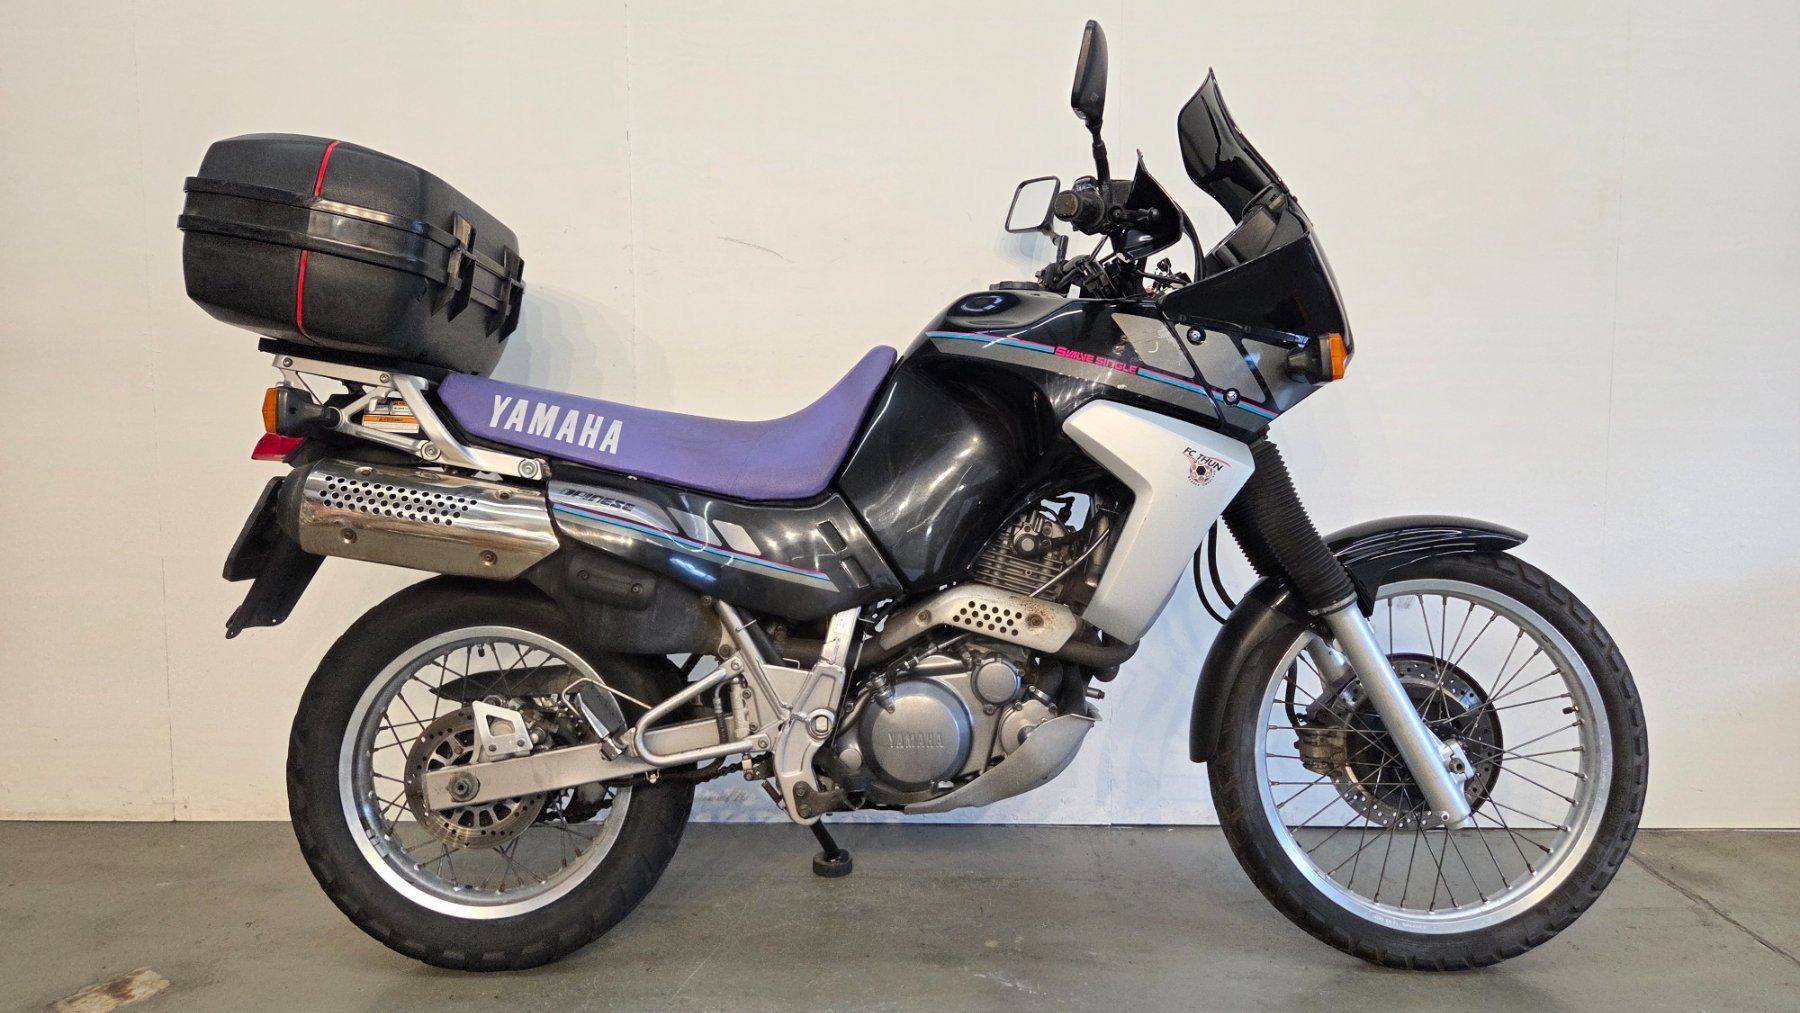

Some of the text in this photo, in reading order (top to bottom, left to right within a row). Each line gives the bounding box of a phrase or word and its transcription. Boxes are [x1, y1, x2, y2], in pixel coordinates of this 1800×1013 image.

[1095, 356, 1138, 375] SINGLE
[489, 394, 623, 454] YAMAHA
[1183, 446, 1224, 471] FC THUN
[887, 731, 945, 749] YAMAHA
